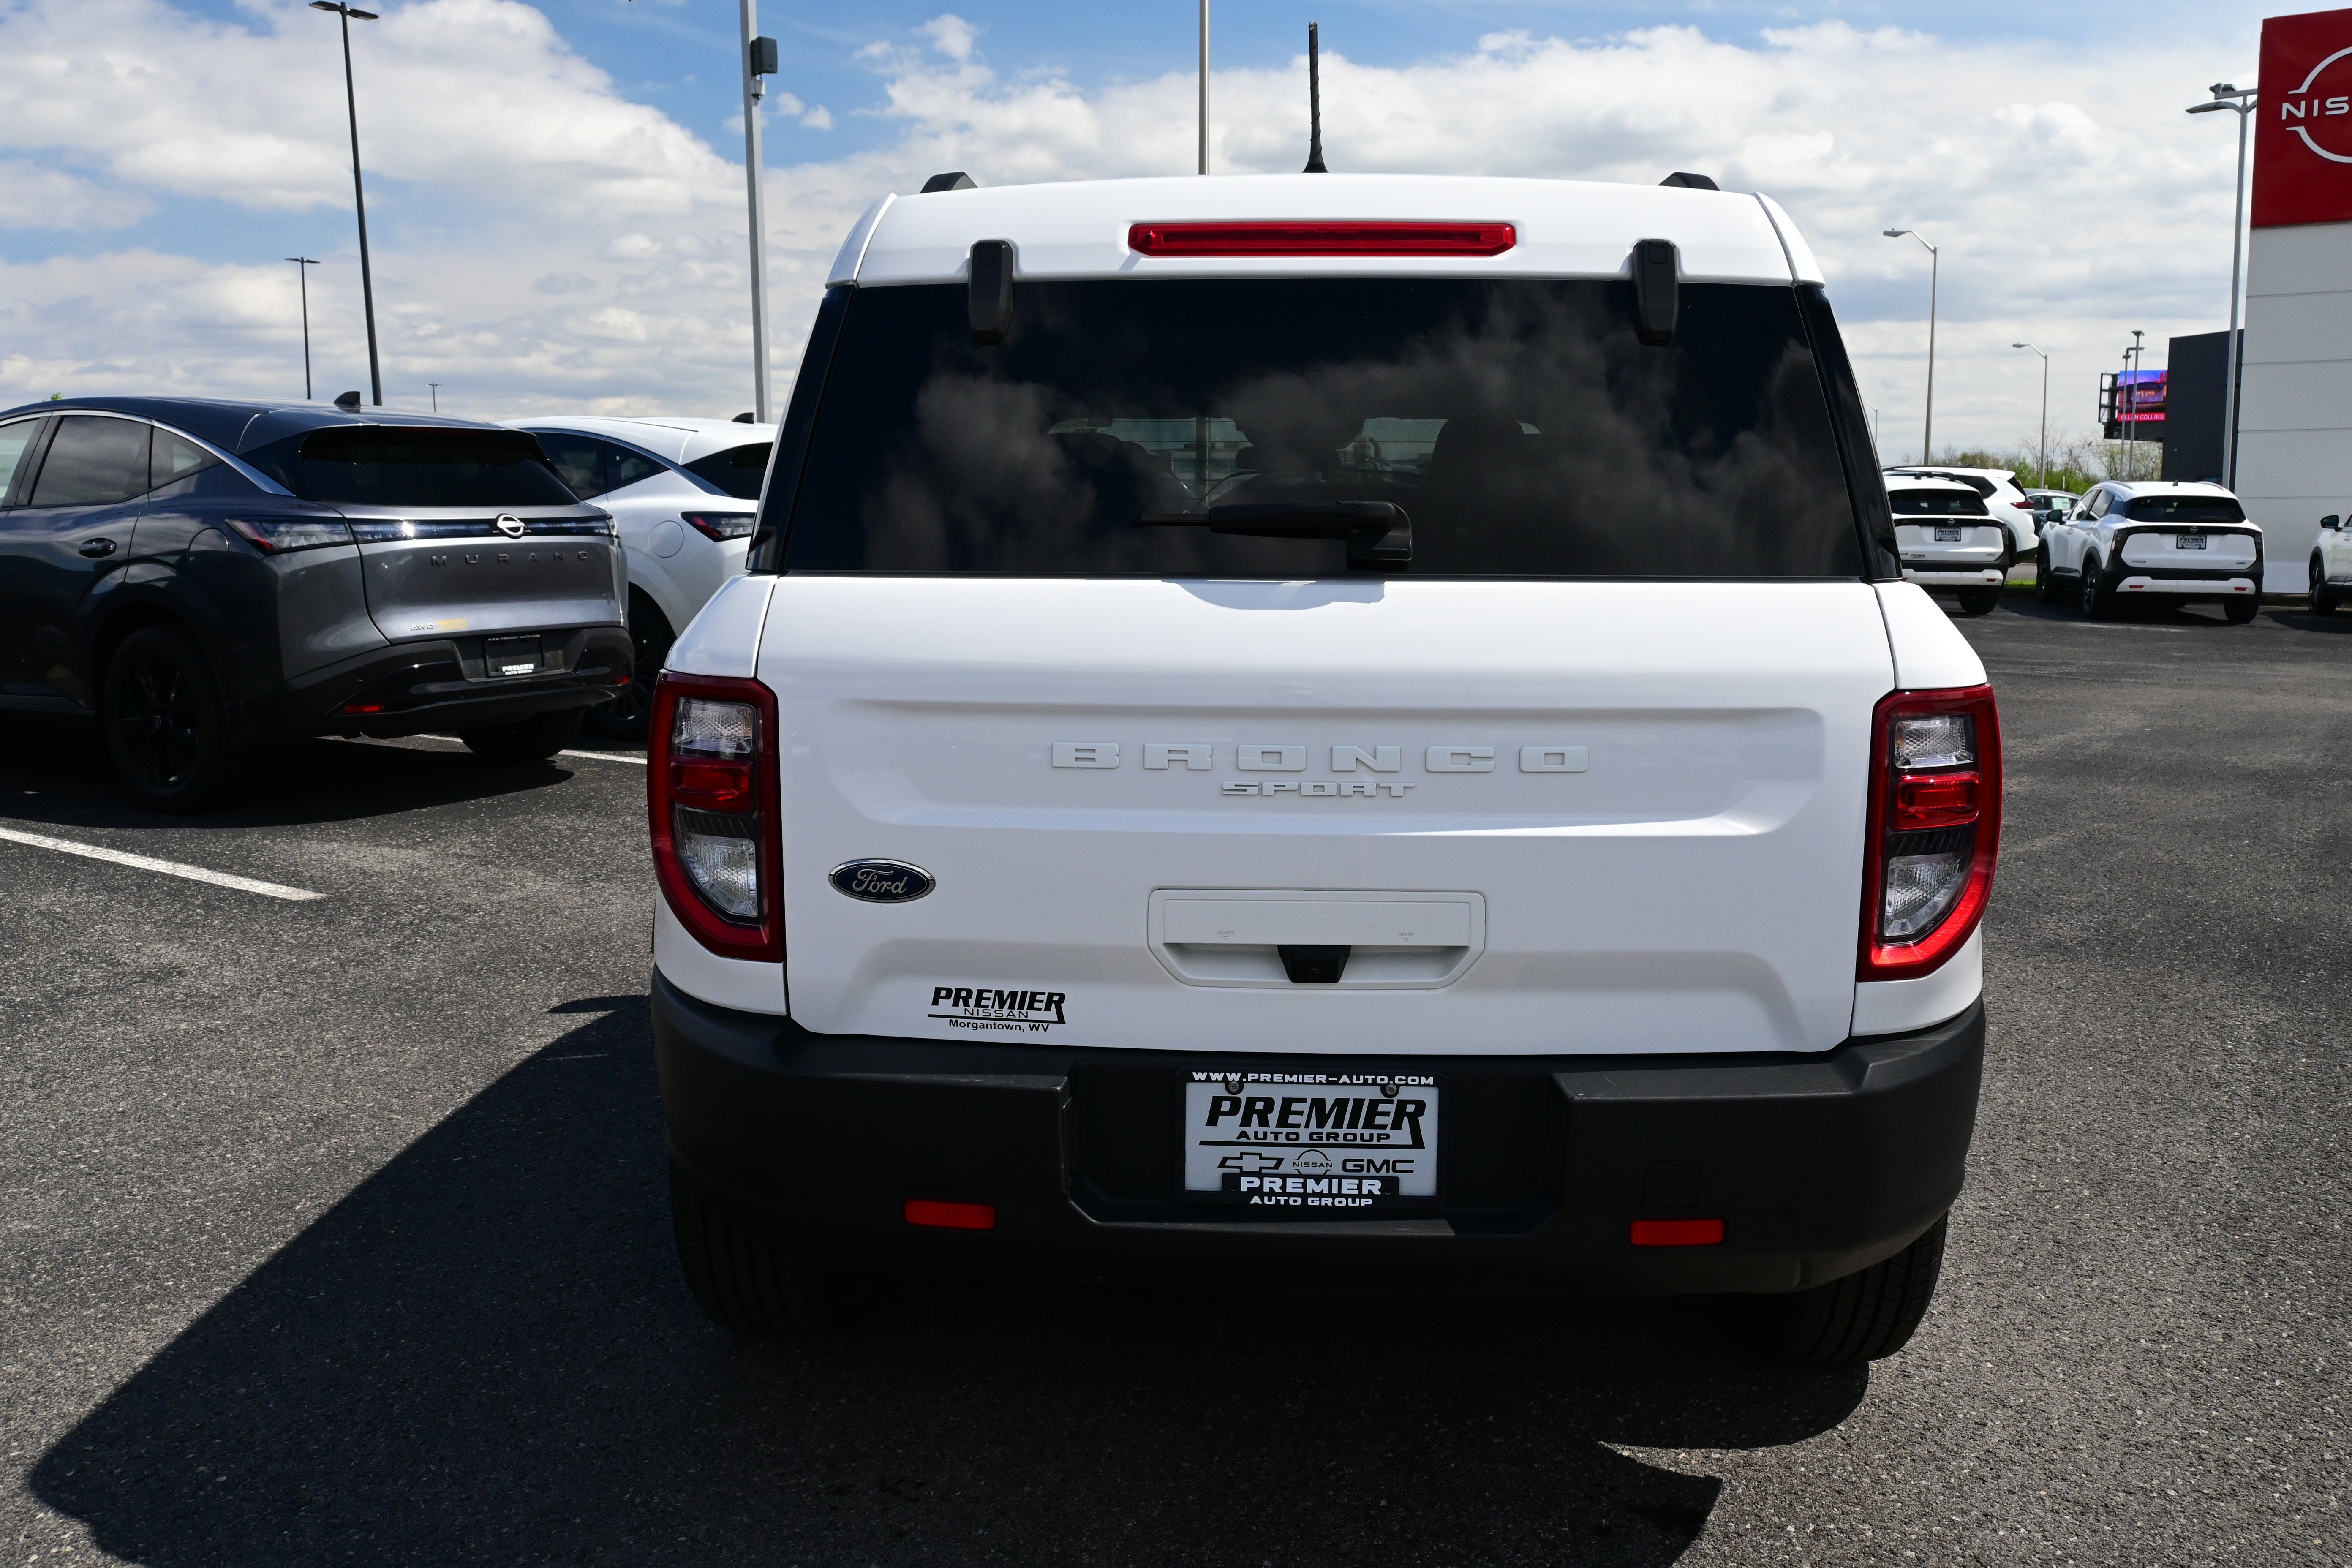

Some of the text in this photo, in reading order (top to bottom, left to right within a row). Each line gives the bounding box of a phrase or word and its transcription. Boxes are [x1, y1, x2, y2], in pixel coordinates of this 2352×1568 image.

[2281, 96, 2349, 120] NIS
[431, 551, 588, 565] MURANO
[411, 623, 434, 631] AWD
[502, 664, 534, 672] PREMIER
[1052, 742, 1588, 773] BRONCO
[1222, 781, 1416, 797] SPORT
[852, 868, 908, 894] Ford
[931, 987, 1066, 1024] PREMIER
[964, 1008, 1028, 1019] NISSAN
[949, 1019, 1049, 1032] Morgantown, WV
[1192, 1072, 1434, 1085] WWW.PREMIER-AUTO.COM
[1205, 1096, 1426, 1149] PREMIER
[1236, 1130, 1391, 1142] AUTO GROUP
[1342, 1158, 1414, 1173] GMC
[1241, 1177, 1382, 1195] PREMIER
[1250, 1196, 1373, 1207] AUTO GROUP
